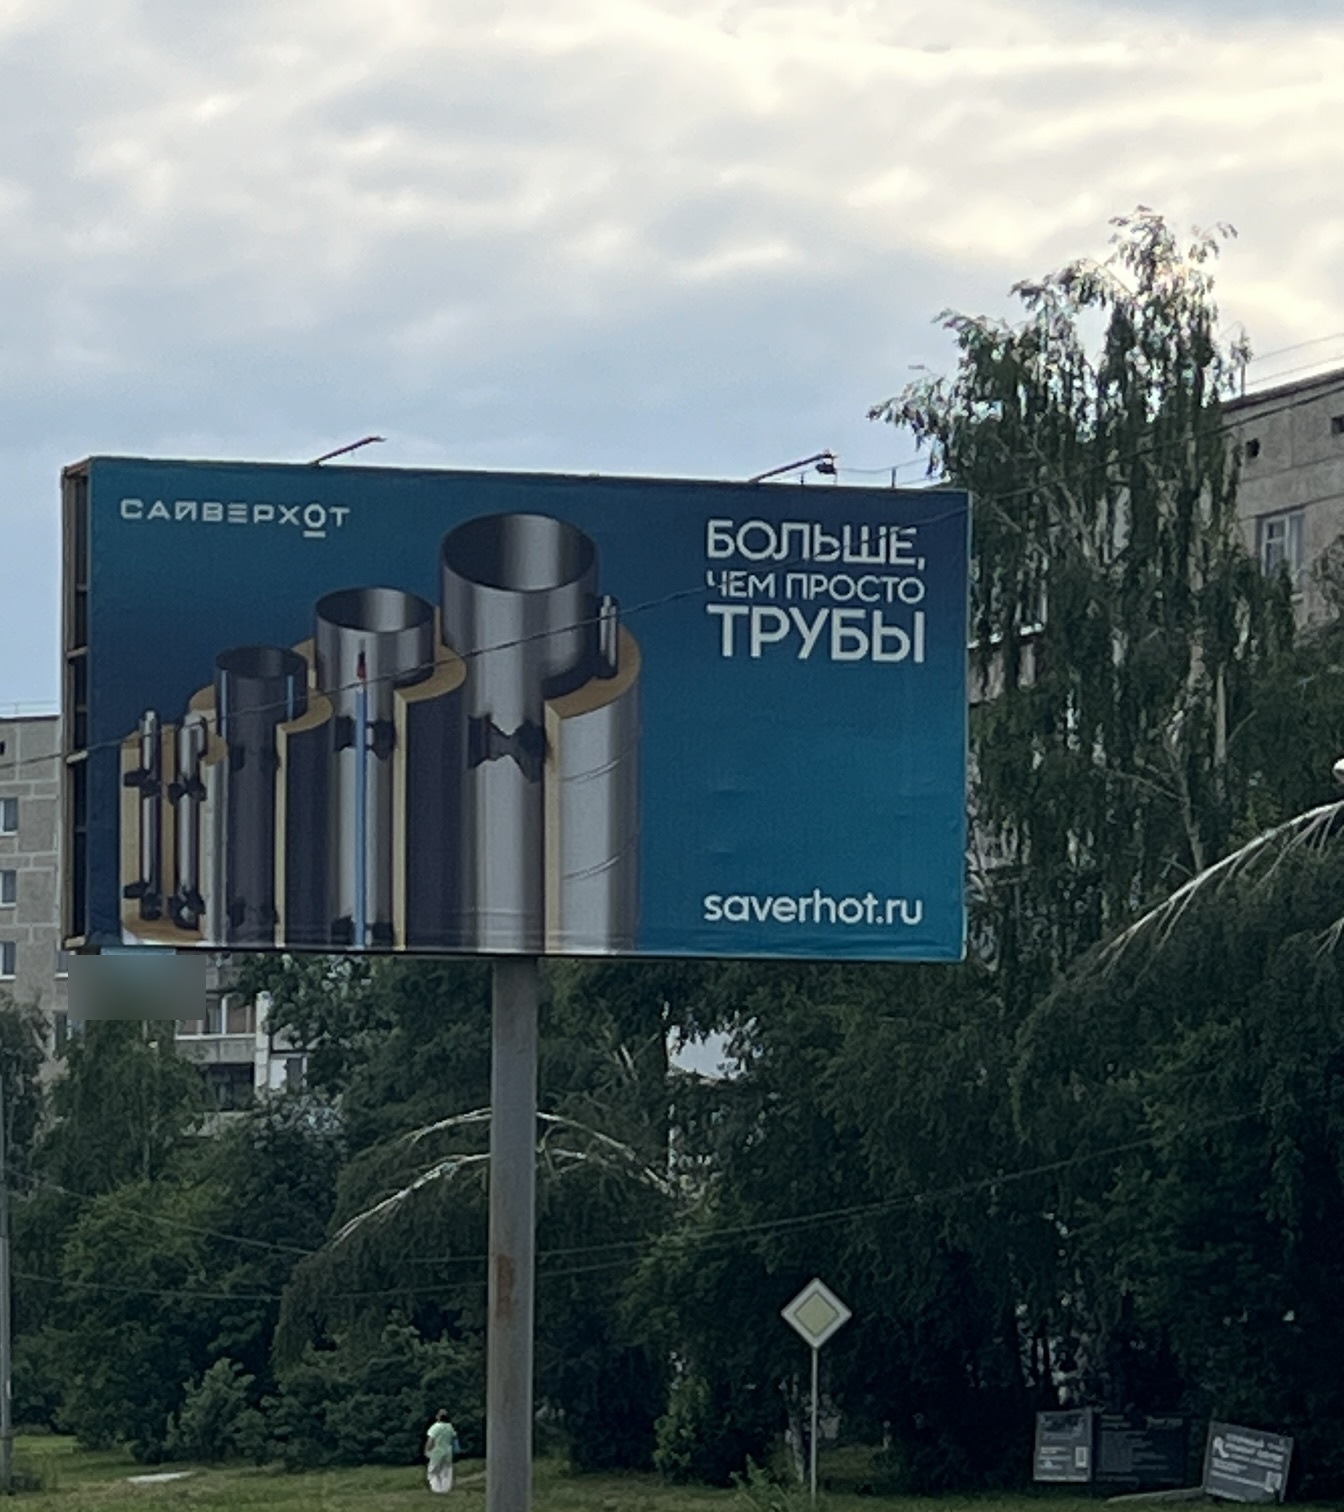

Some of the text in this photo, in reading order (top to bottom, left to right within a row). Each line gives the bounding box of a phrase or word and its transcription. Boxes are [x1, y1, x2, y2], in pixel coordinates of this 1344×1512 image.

[707, 519, 925, 570] БОЛЬШЕ,
[707, 570, 925, 604] ЧЕМ ПРОСТО
[707, 604, 924, 663] ТРУБЫ
[704, 888, 922, 925] saverhot.ru
